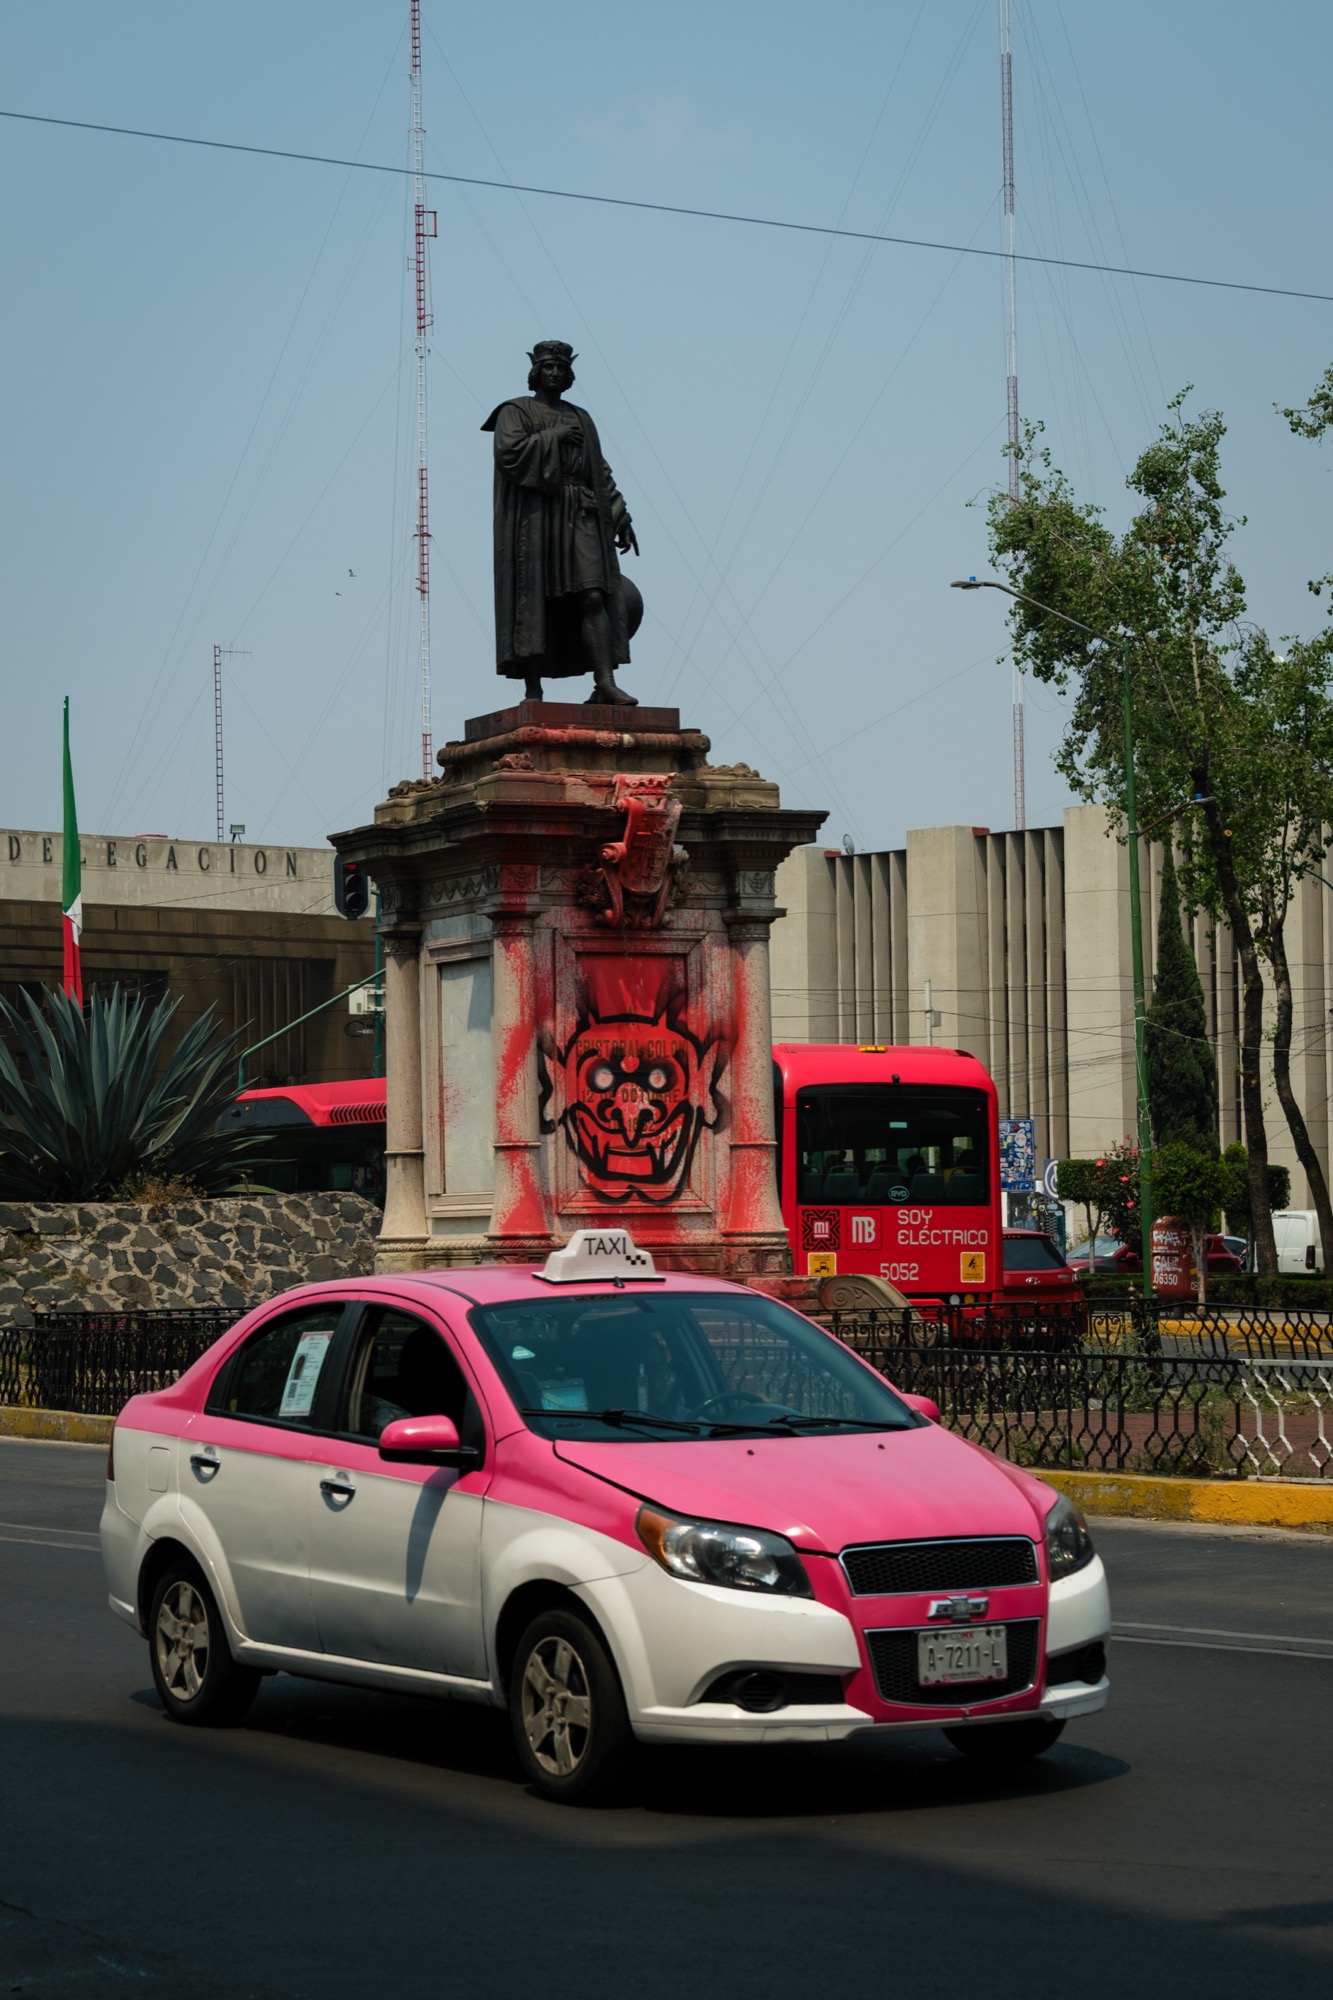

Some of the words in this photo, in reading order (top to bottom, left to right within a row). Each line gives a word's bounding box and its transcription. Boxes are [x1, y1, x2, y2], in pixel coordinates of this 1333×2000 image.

[582, 708, 632, 721] COLON
[897, 1209, 933, 1225] SOY
[851, 1216, 875, 1243] MB
[897, 1225, 989, 1245] ELÉCTRICO
[584, 1237, 627, 1255] TAXI
[880, 1262, 919, 1281] 5052
[927, 1641, 1000, 1672] A-7211-L
